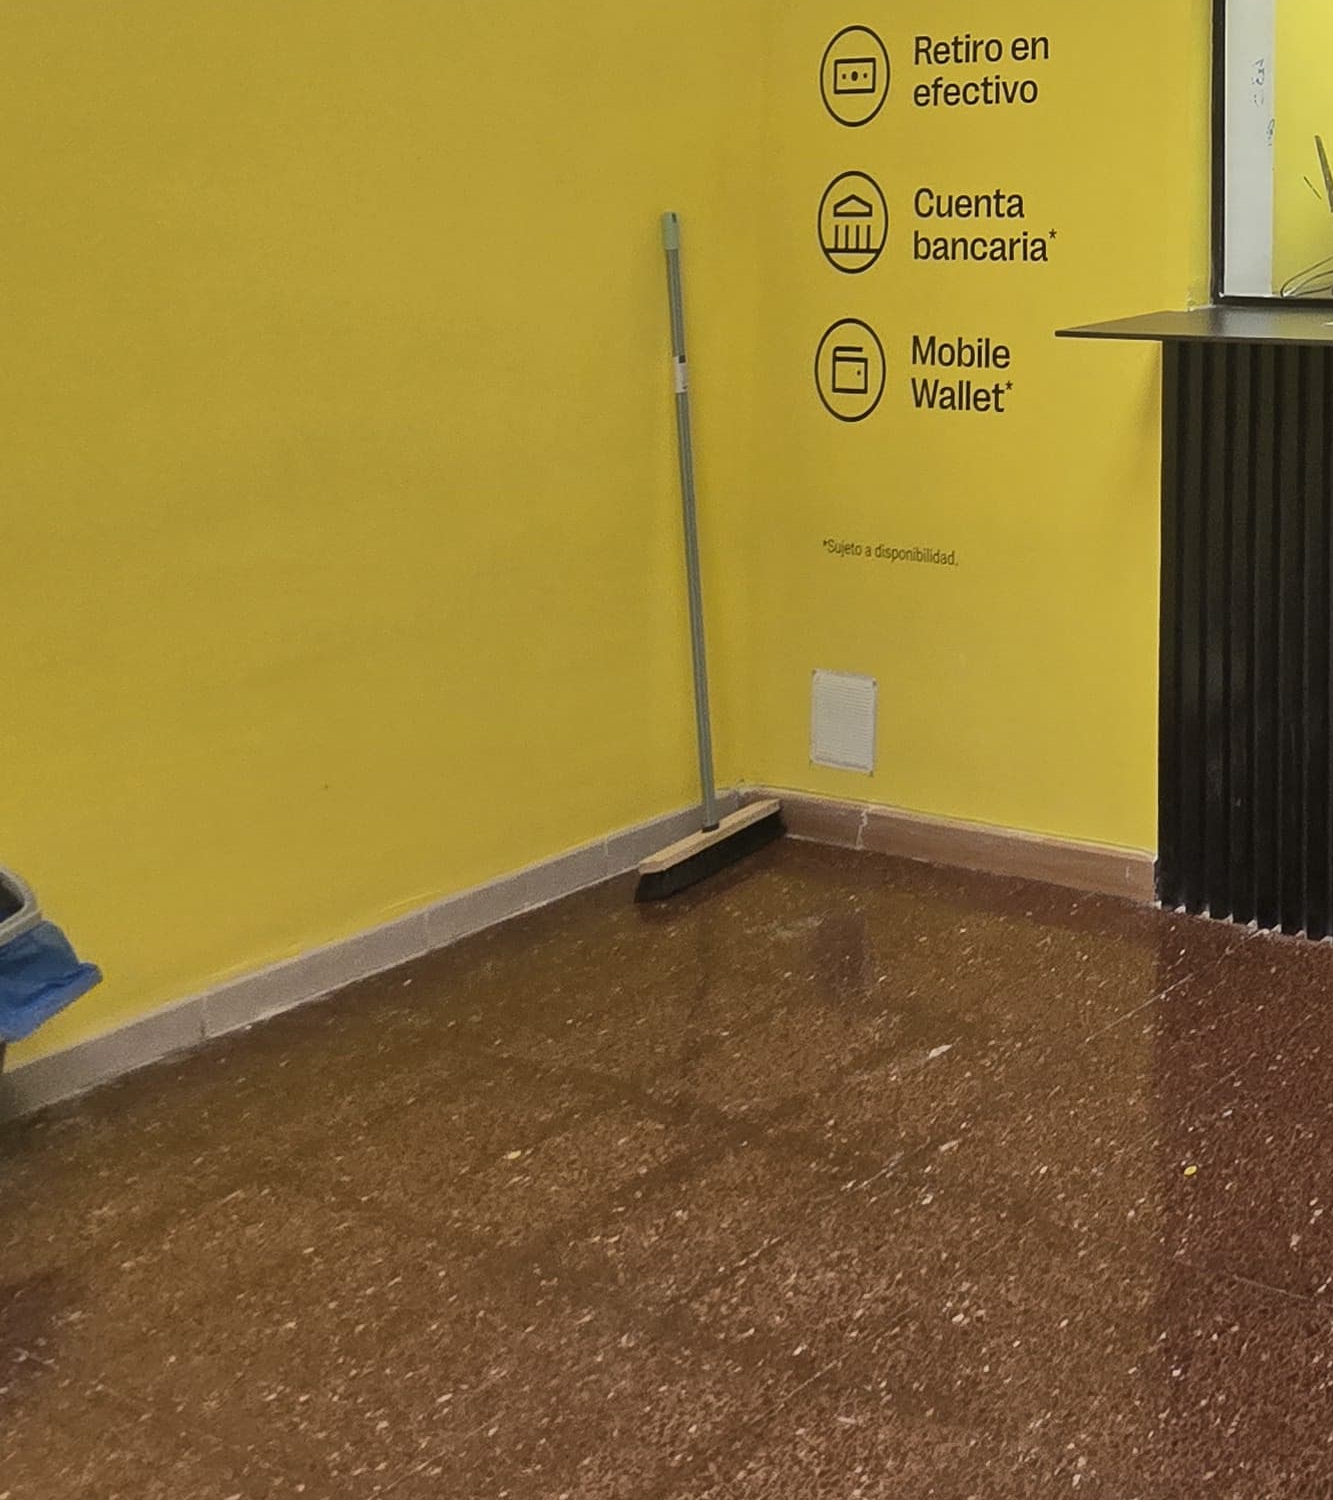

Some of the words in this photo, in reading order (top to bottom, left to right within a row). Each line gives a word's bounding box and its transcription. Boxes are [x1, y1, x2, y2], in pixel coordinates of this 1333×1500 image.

[914, 34, 1002, 65] Retiro
[1011, 35, 1049, 61] en
[913, 75, 1038, 107] efectivo
[914, 187, 1025, 218] Cuenta
[911, 335, 1010, 368] Mobile
[865, 546, 872, 557] a
